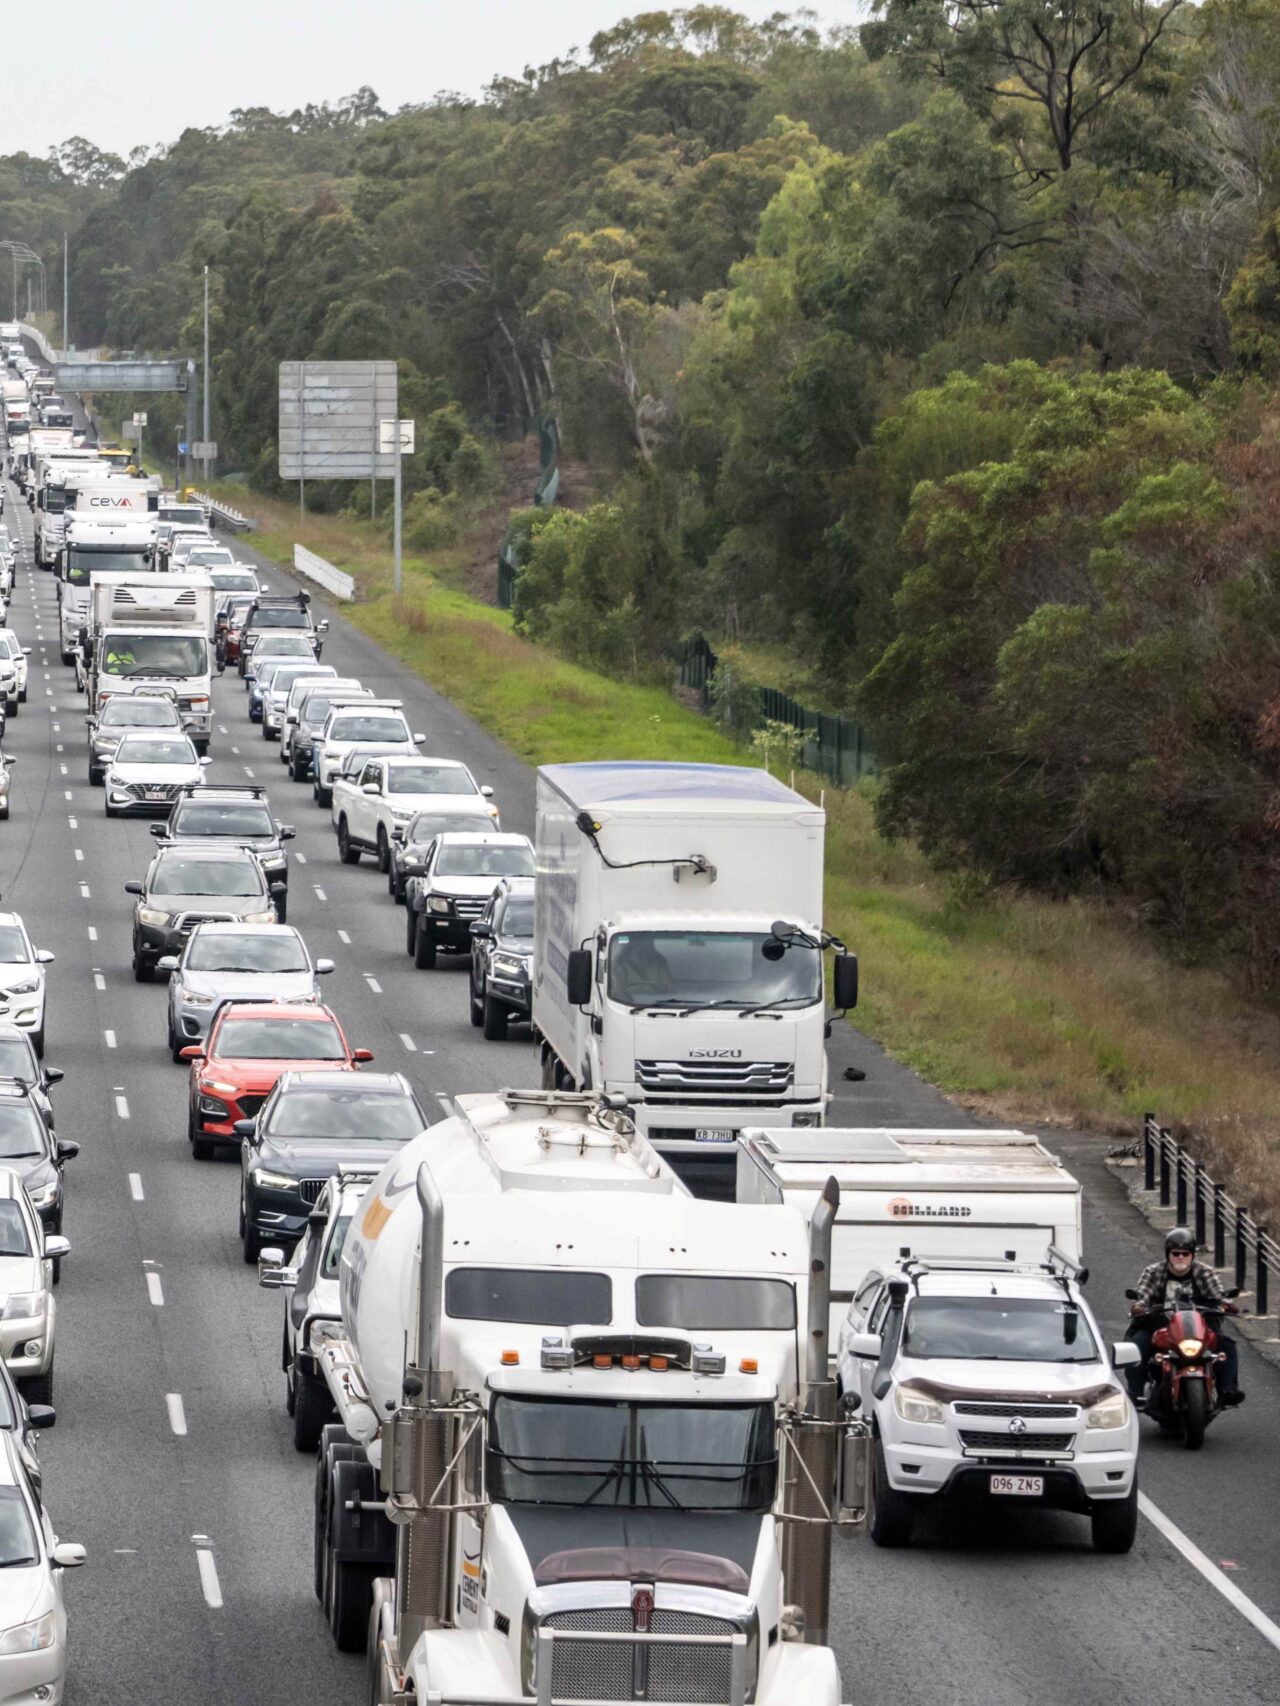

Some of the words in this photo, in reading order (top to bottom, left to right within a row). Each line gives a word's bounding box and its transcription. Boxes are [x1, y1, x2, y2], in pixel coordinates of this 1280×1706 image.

[689, 1048, 742, 1058] ISUZU
[893, 1205, 972, 1217] MILLARD
[992, 1477, 1013, 1490] 096
[1017, 1478, 1041, 1491] ZNS
